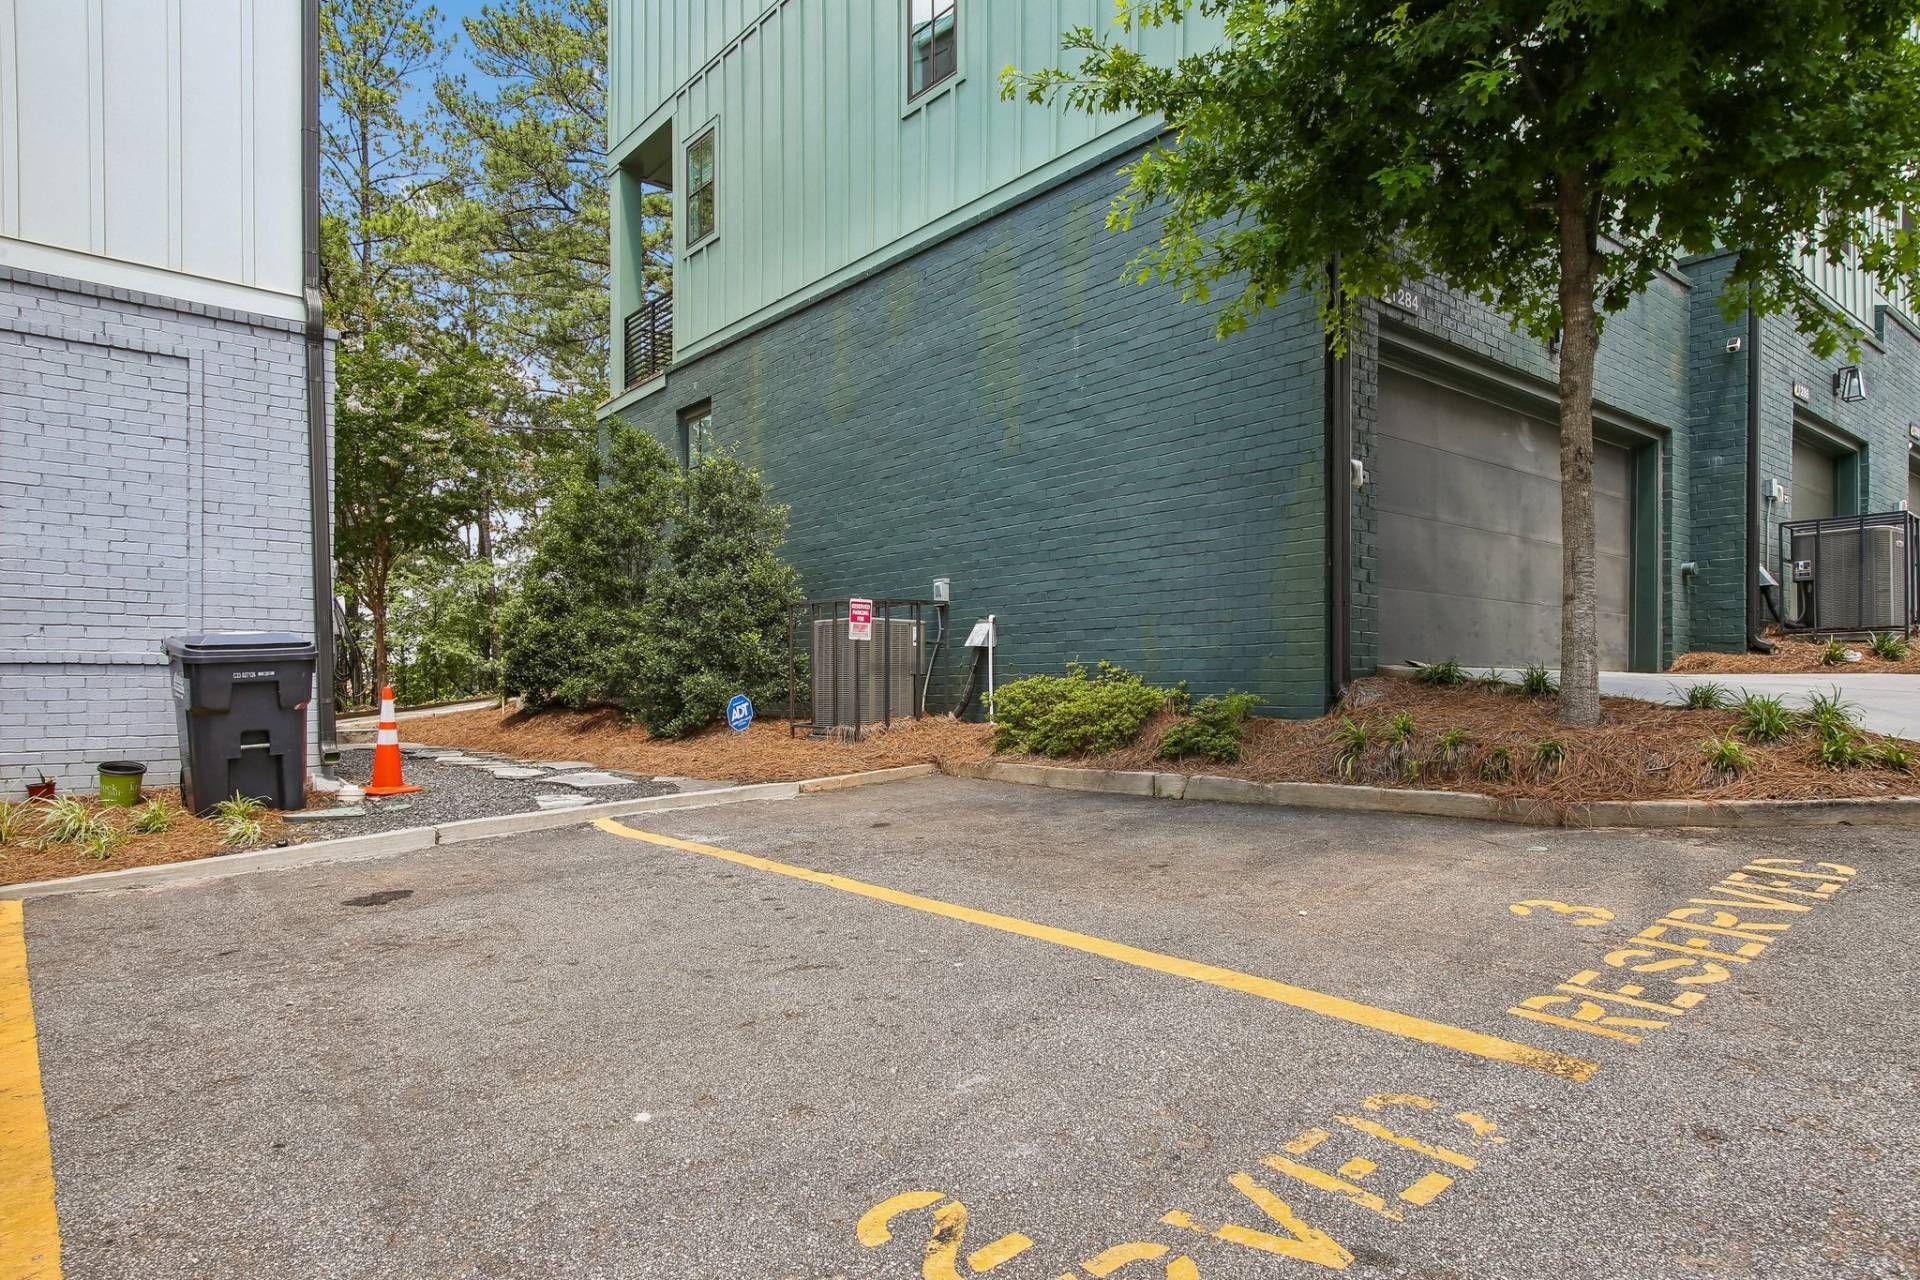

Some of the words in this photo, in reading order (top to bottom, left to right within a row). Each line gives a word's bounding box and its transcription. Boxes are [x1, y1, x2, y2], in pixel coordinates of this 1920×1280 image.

[731, 701, 749, 721] ADT
[1508, 899, 1616, 926] 3
[1507, 858, 1857, 1044] RESERVED
